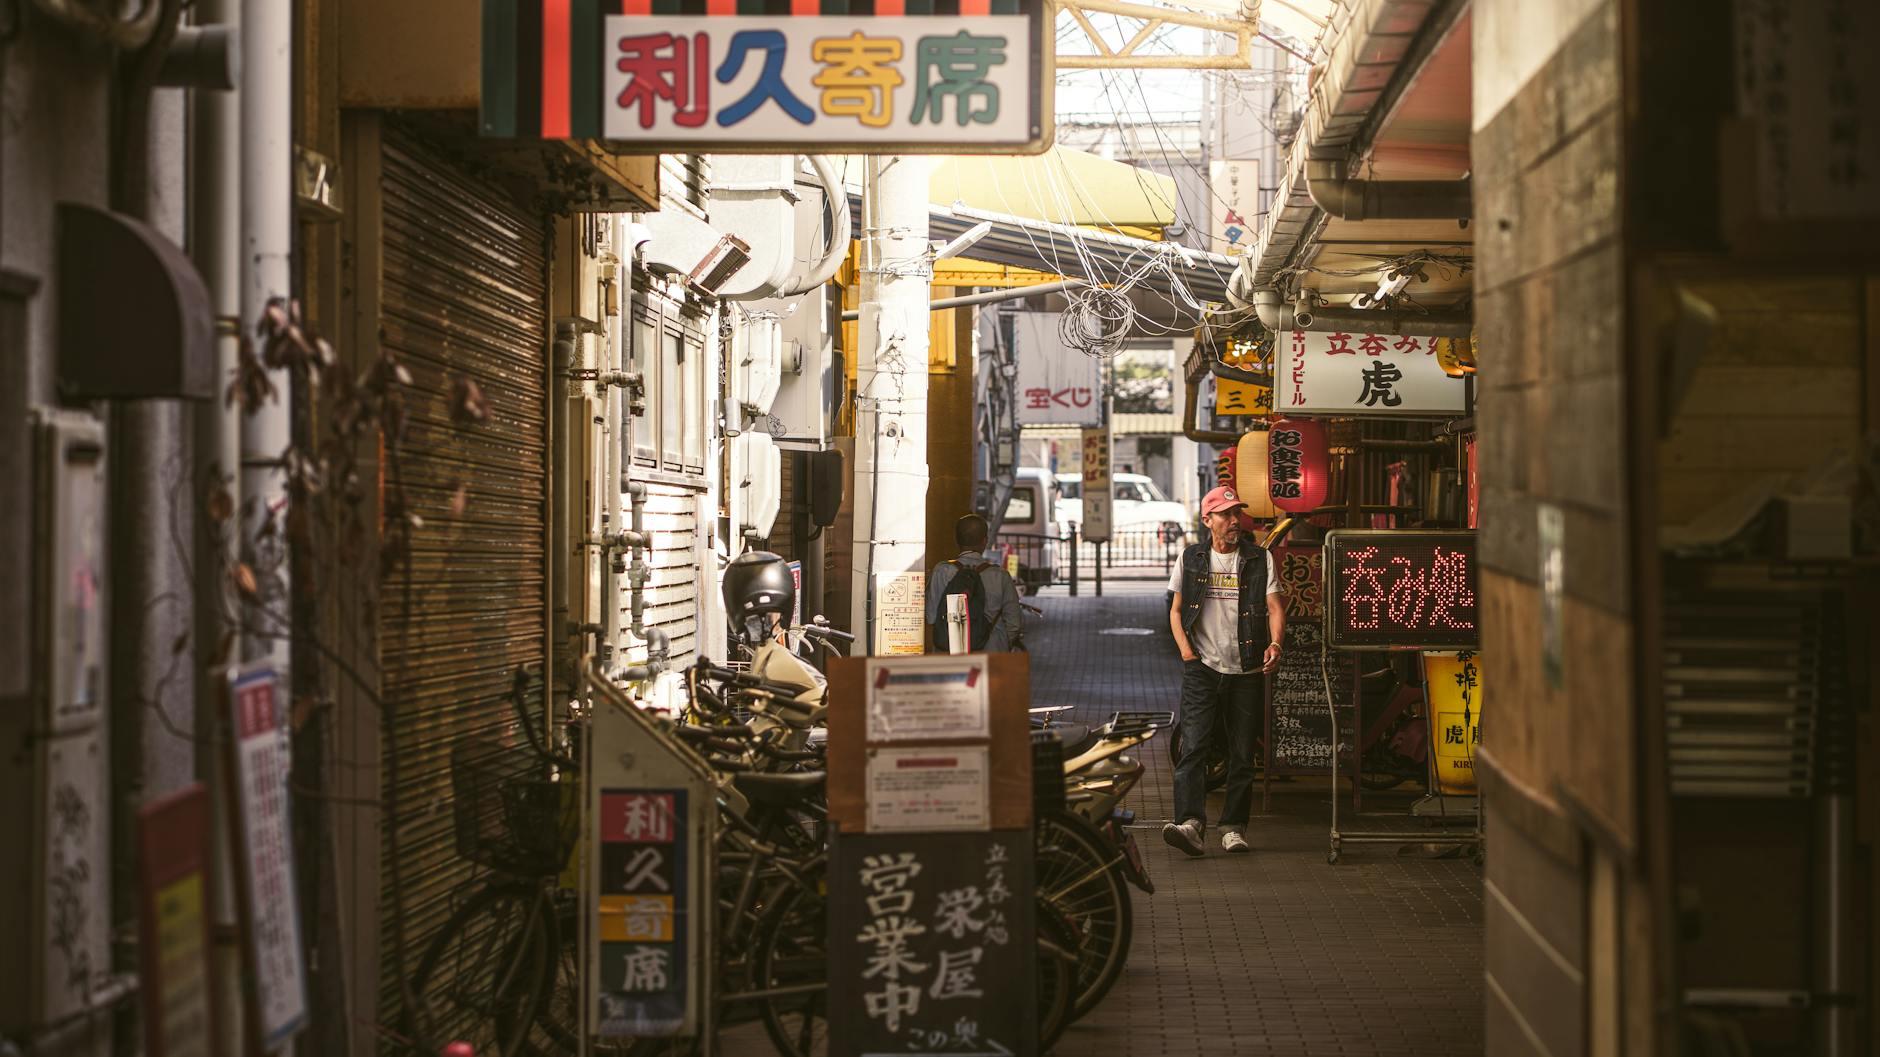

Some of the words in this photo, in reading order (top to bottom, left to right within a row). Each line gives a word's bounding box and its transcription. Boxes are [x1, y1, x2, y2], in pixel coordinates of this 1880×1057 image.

[616, 29, 1008, 130] 利久寄席
[1025, 387, 1092, 409] 宝くじ
[1291, 330, 1307, 406] キリンビール
[1353, 360, 1403, 407] 虎
[1270, 429, 1304, 499] お食事処
[1281, 552, 1318, 616] おでん
[1342, 546, 1474, 629] 呑み処
[1276, 715, 1303, 729] 冷奴
[623, 794, 669, 993] 利久寄席
[856, 852, 930, 1033] 営業中
[929, 885, 986, 1000] 栄屋
[906, 1015, 979, 1050] この奥
